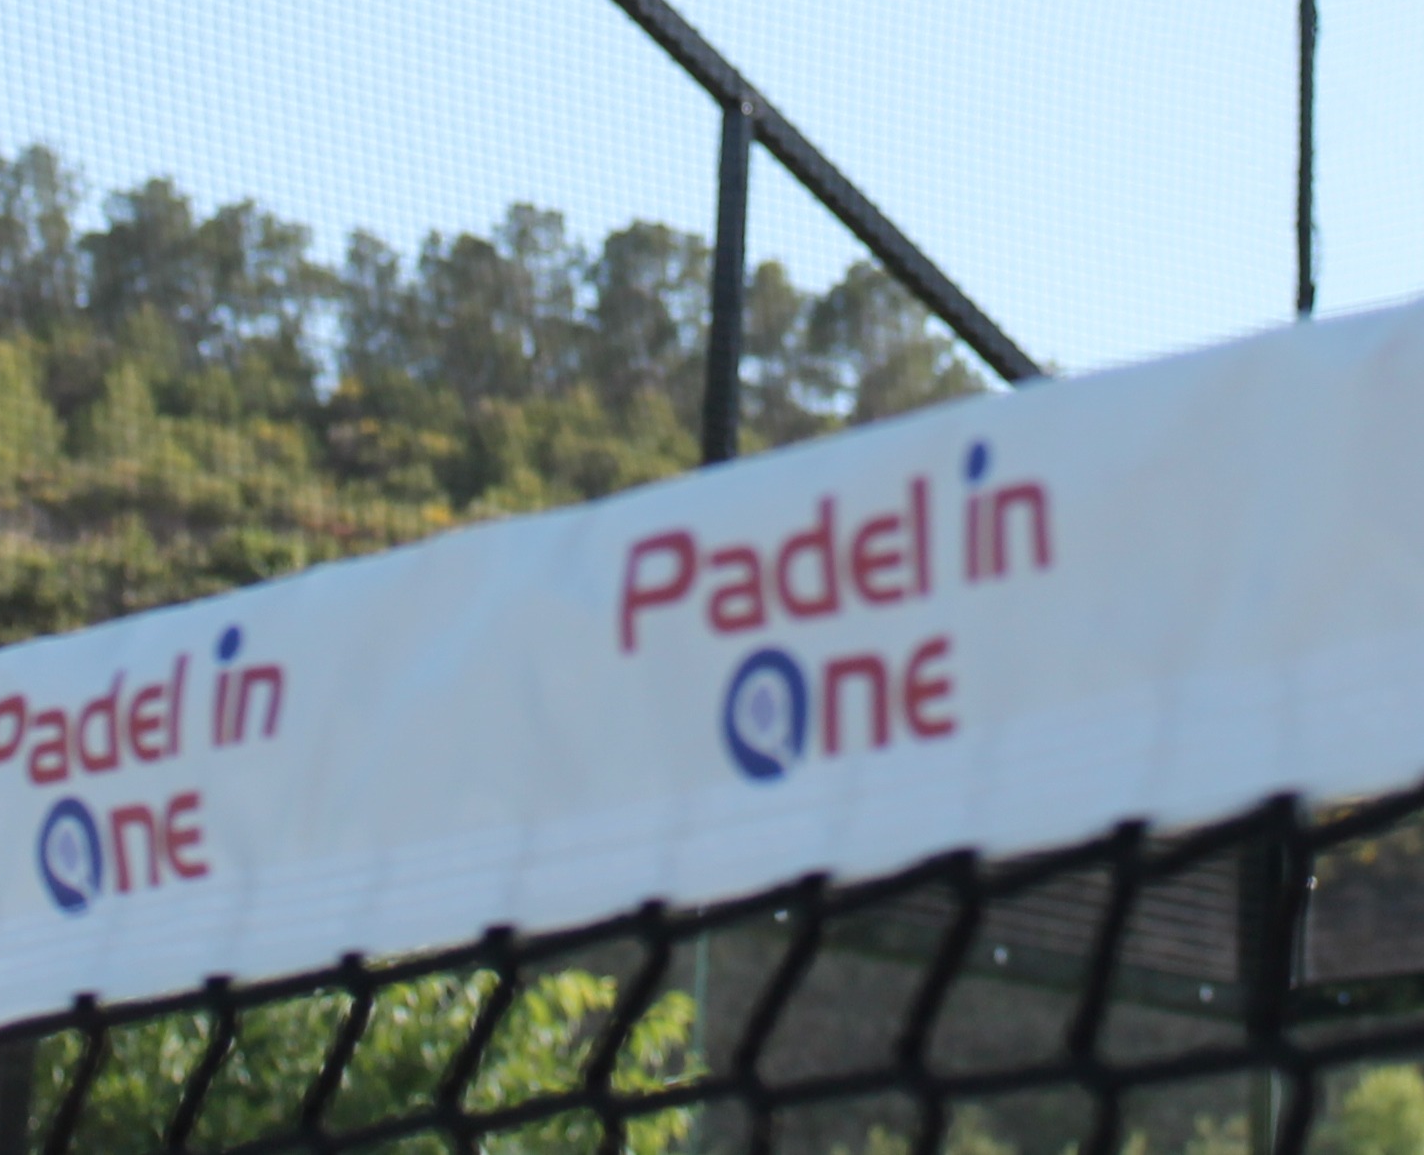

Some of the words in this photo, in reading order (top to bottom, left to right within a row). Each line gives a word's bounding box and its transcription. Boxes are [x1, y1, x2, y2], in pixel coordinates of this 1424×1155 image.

[618, 475, 933, 655] Padel
[961, 439, 1054, 586] in
[211, 624, 284, 748] in
